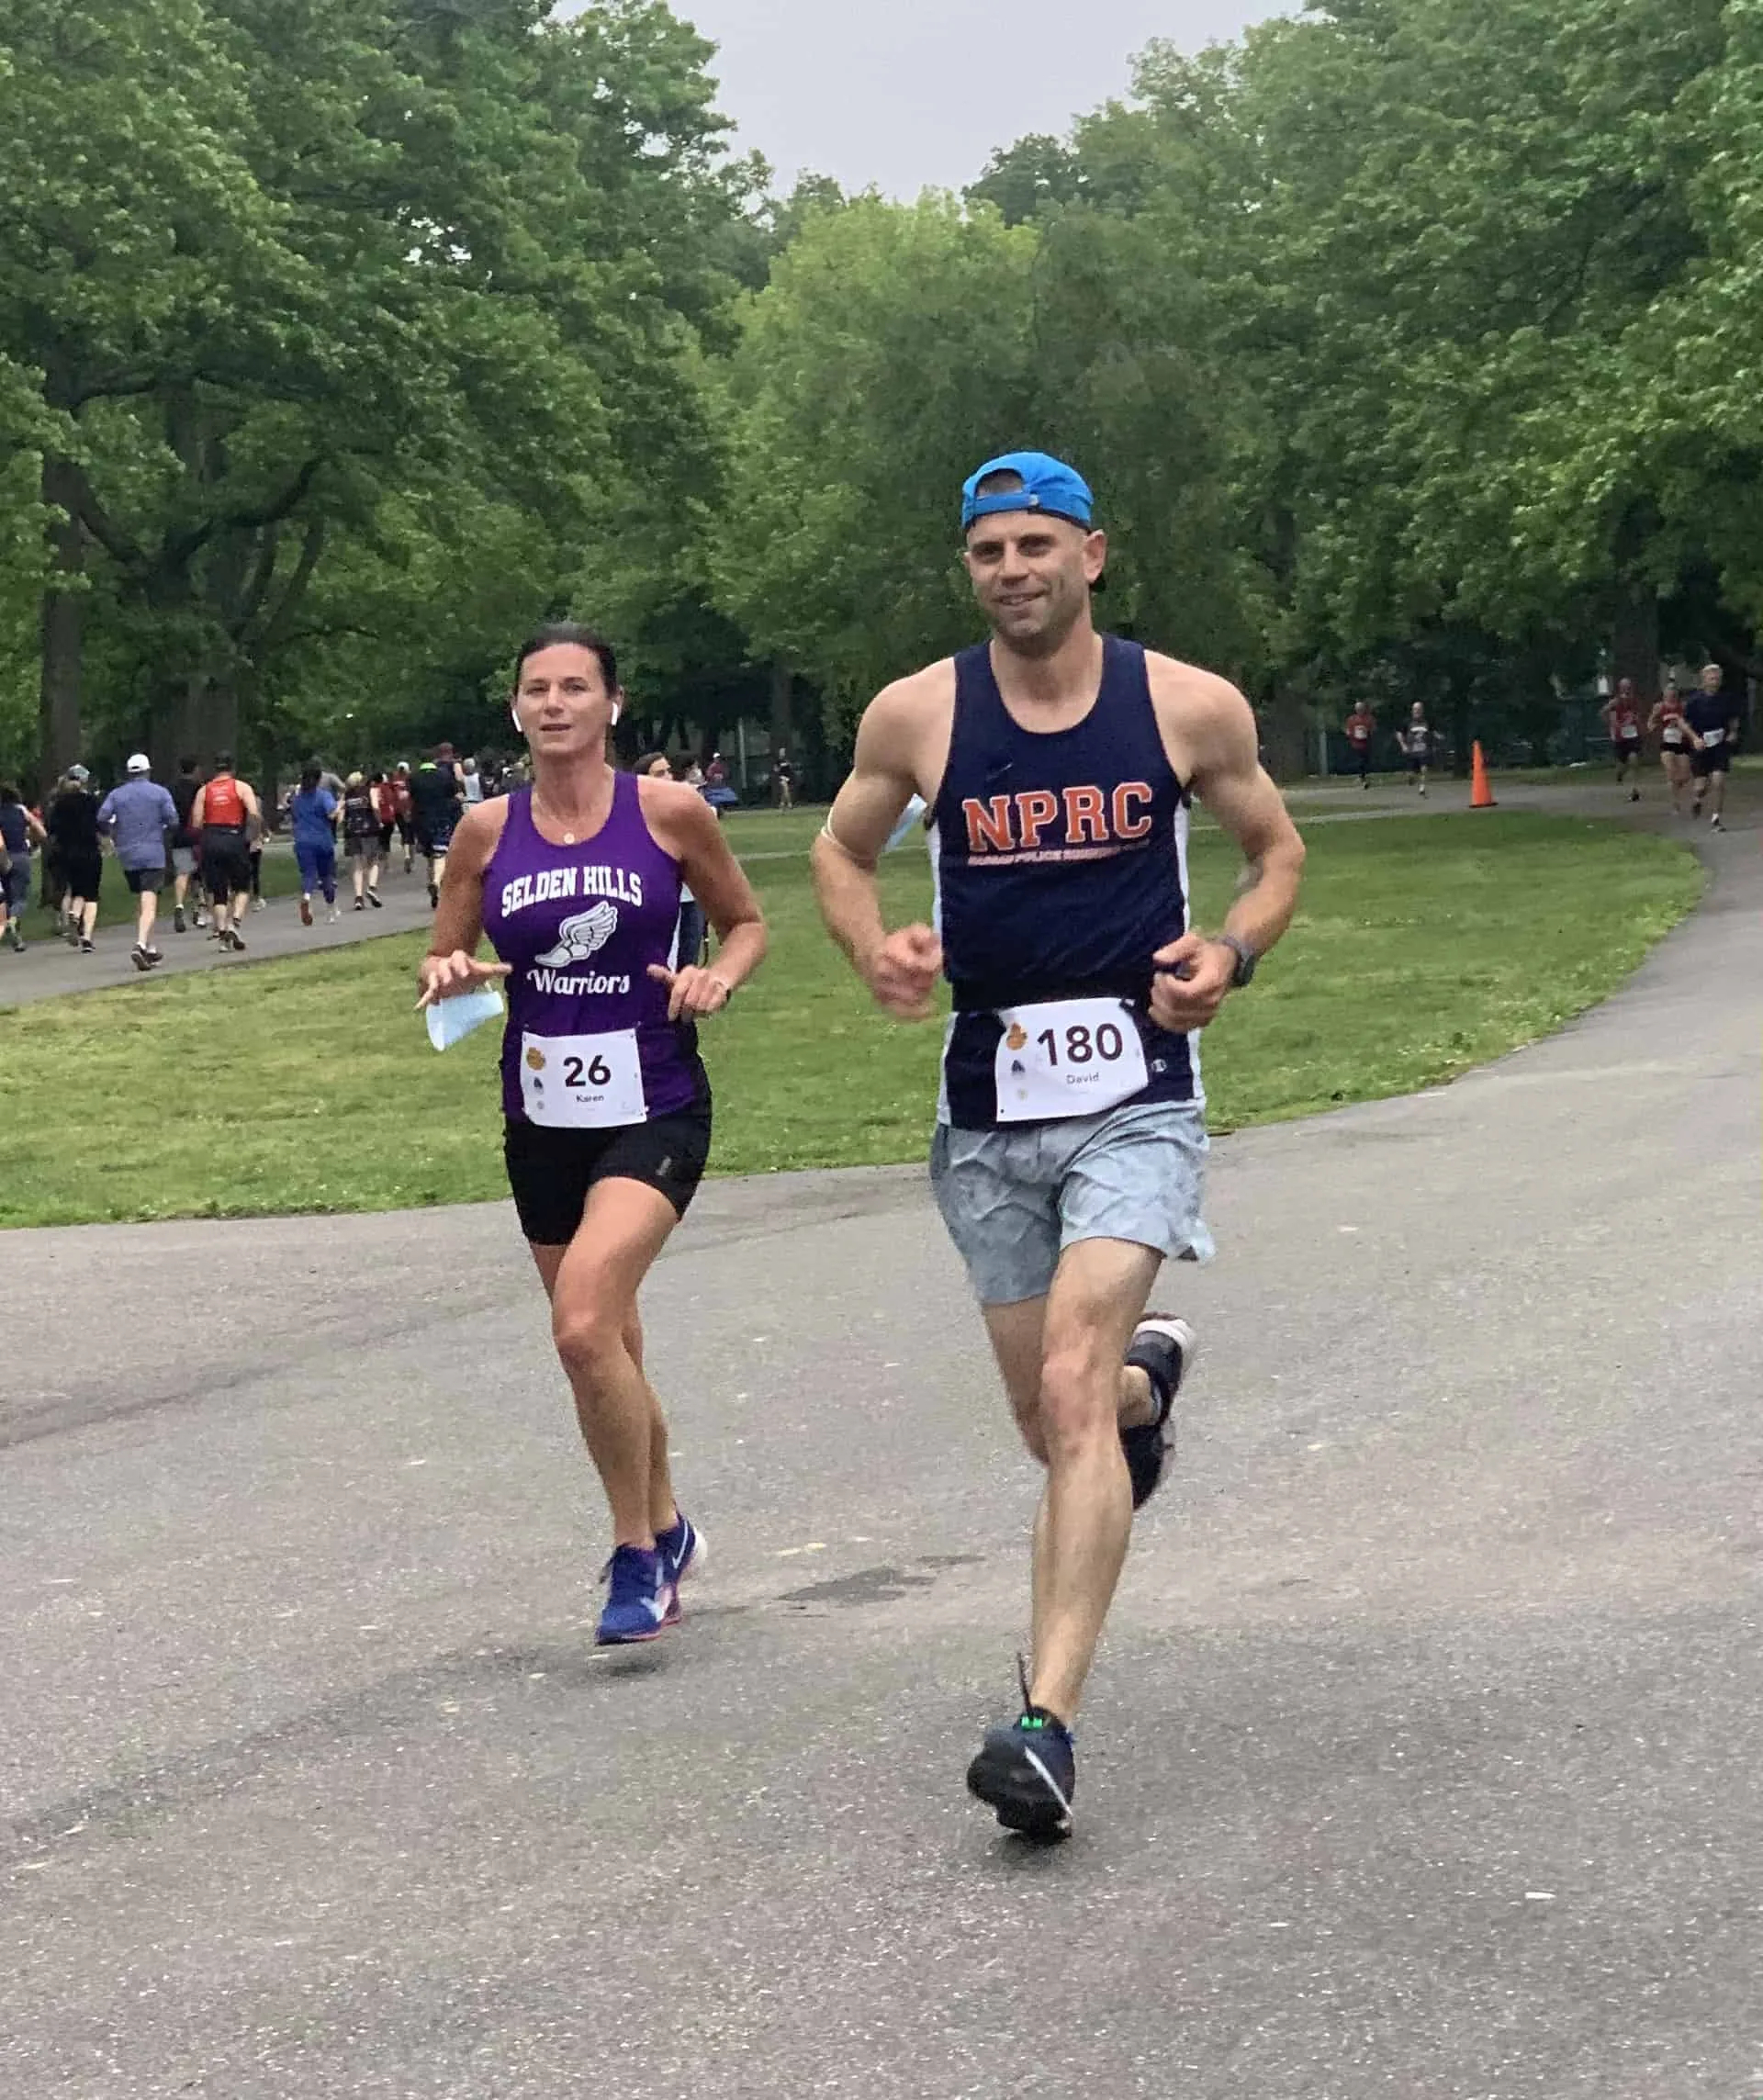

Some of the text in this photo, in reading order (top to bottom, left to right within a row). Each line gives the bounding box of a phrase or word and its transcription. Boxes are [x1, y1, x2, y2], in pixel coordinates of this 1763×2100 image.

[962, 782, 1152, 852] NPRC
[501, 866, 643, 917] SELDEN HILLS
[526, 969, 631, 995] Warriors
[1037, 1023, 1123, 1067] 180
[563, 1054, 612, 1087] 26
[1066, 1072, 1099, 1084] David
[576, 1094, 605, 1103] Karen
